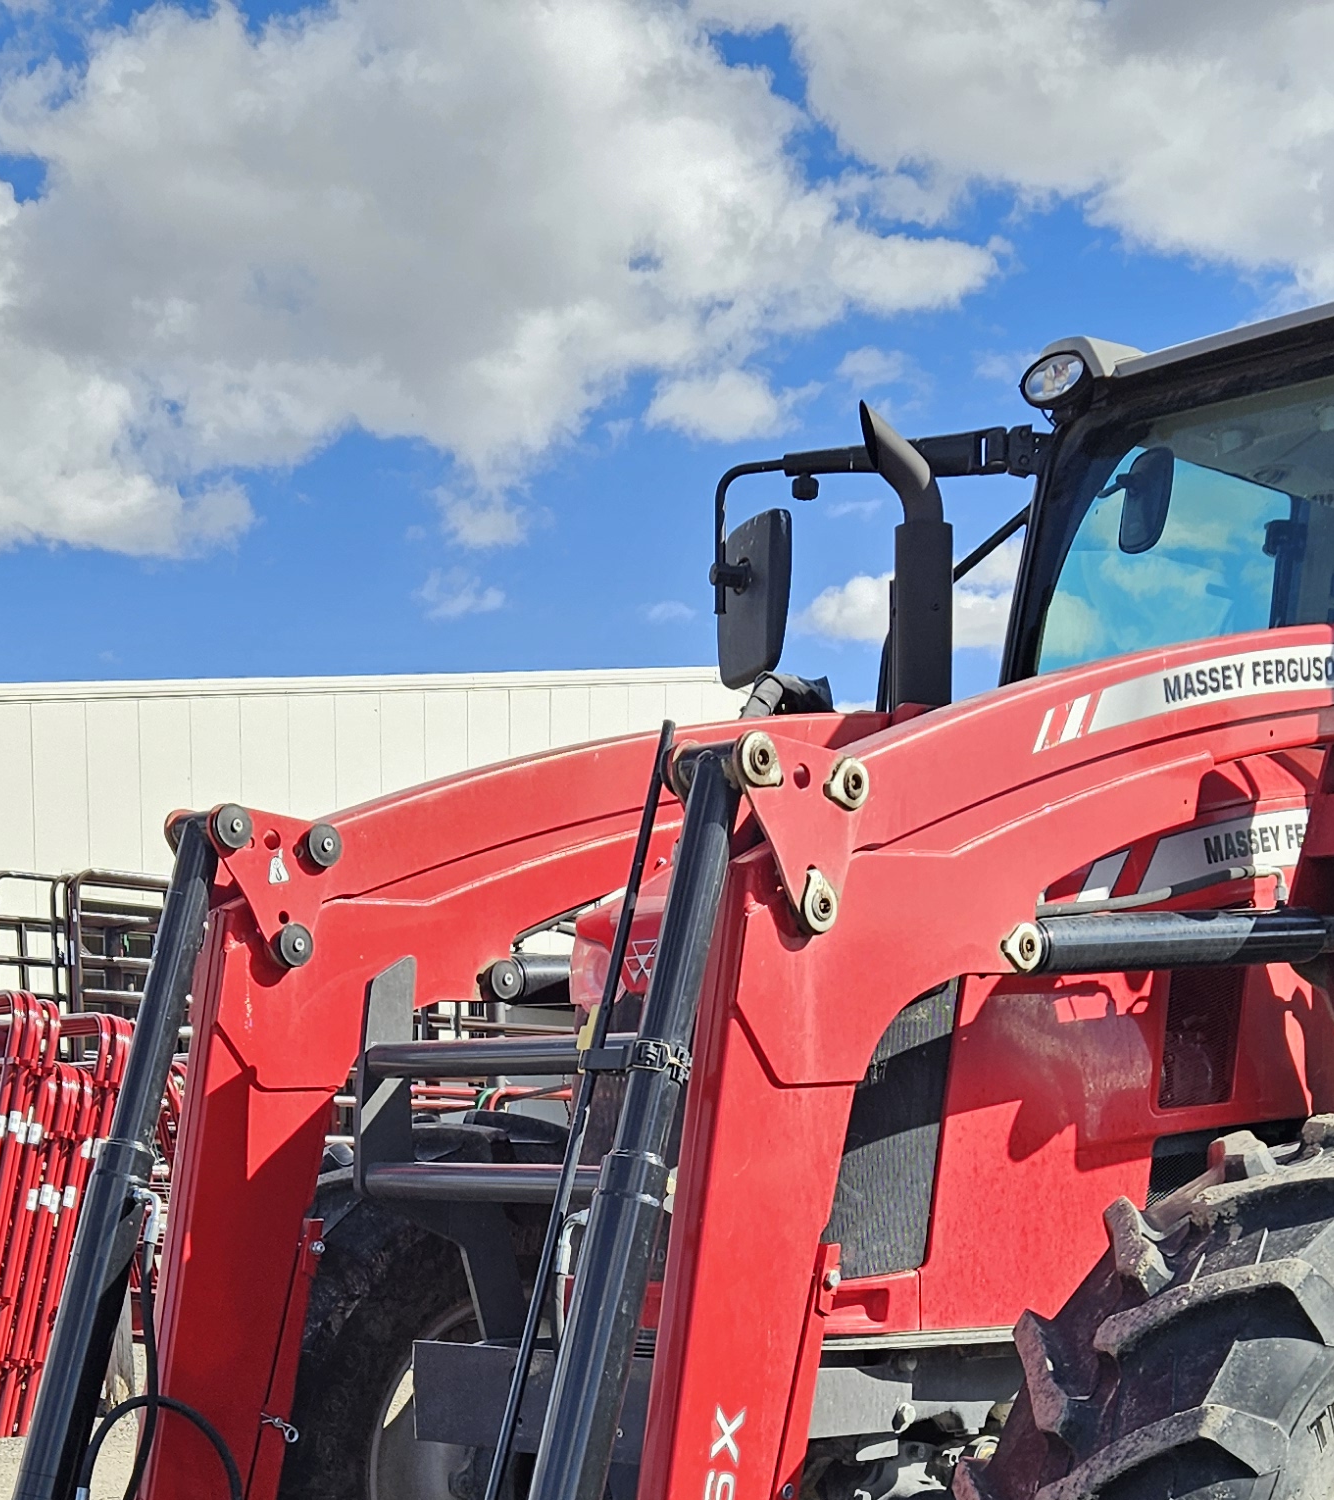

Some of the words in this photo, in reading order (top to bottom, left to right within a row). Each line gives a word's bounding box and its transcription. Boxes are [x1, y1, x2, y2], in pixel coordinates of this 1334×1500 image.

[1163, 662, 1245, 704] MASSEY
[1203, 825, 1280, 865] MASSEY
[1284, 822, 1308, 850] FE
